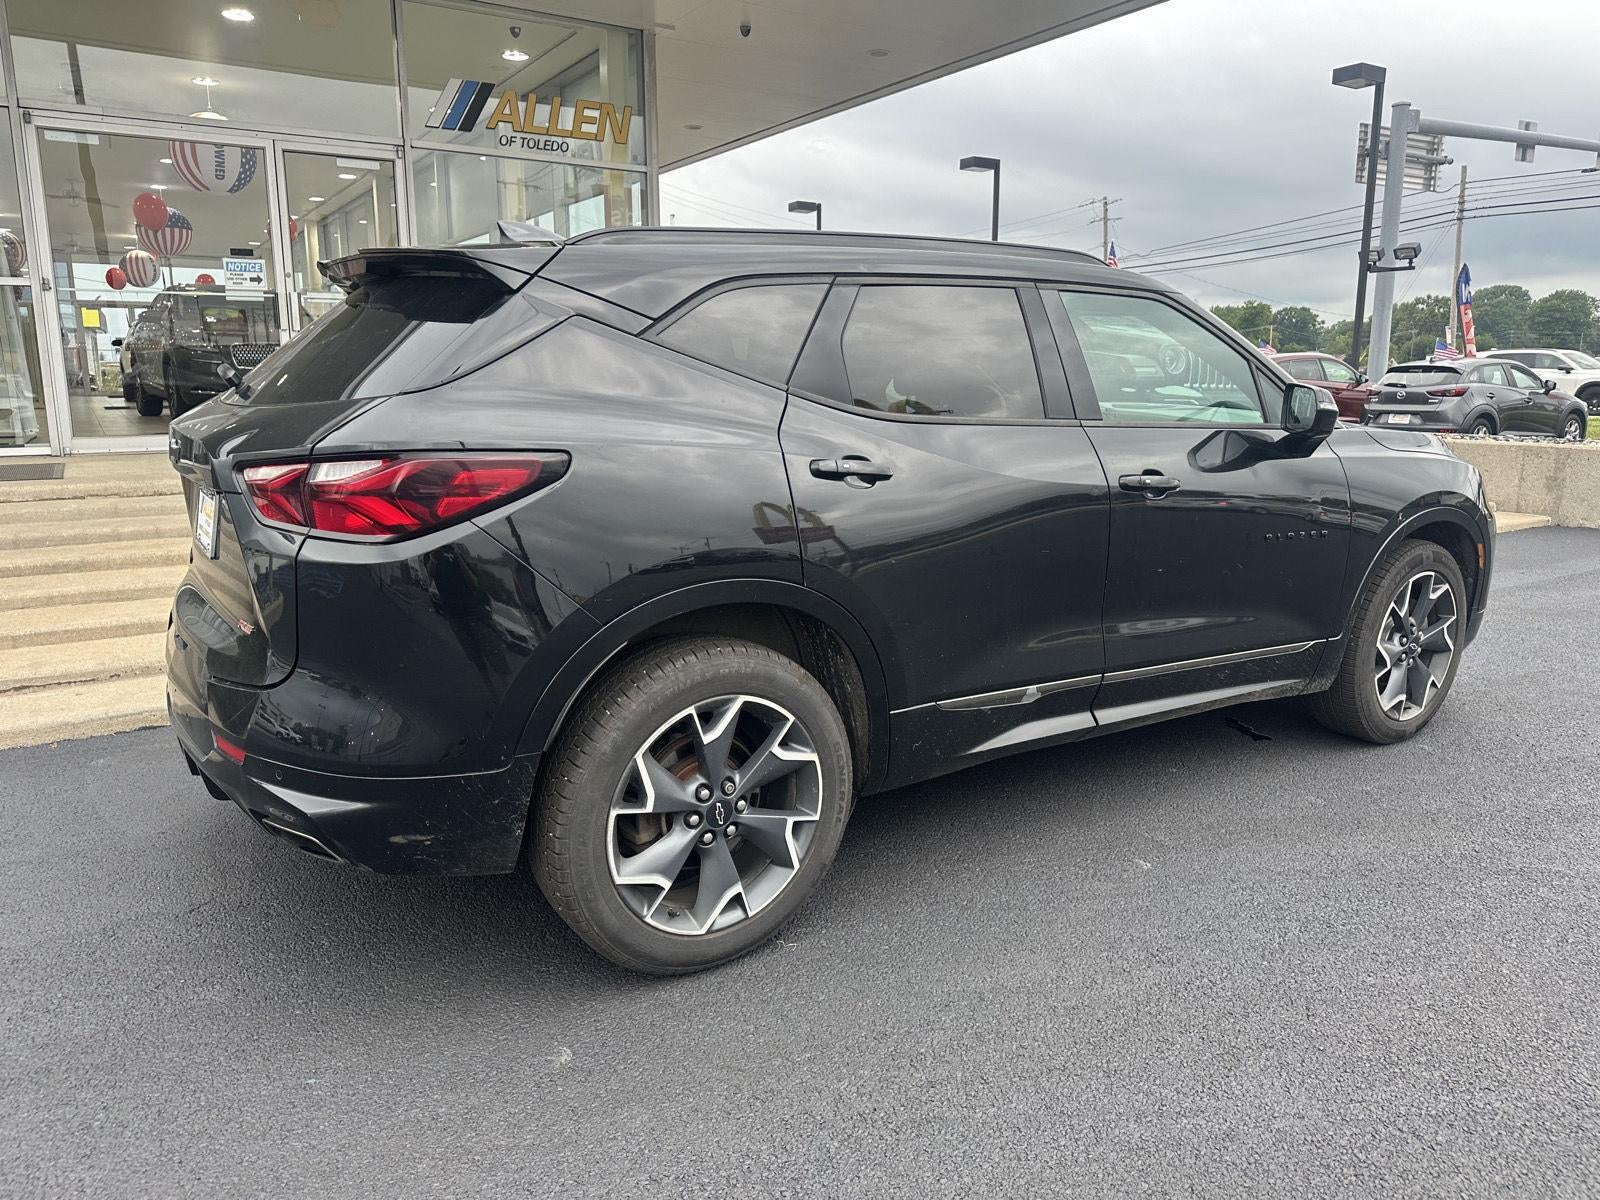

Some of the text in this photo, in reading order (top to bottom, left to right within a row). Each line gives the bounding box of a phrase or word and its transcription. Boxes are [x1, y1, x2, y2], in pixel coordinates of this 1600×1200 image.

[486, 88, 633, 145] ALLEN
[499, 134, 570, 153] OF TOLEDO
[228, 262, 261, 272] NOTICE
